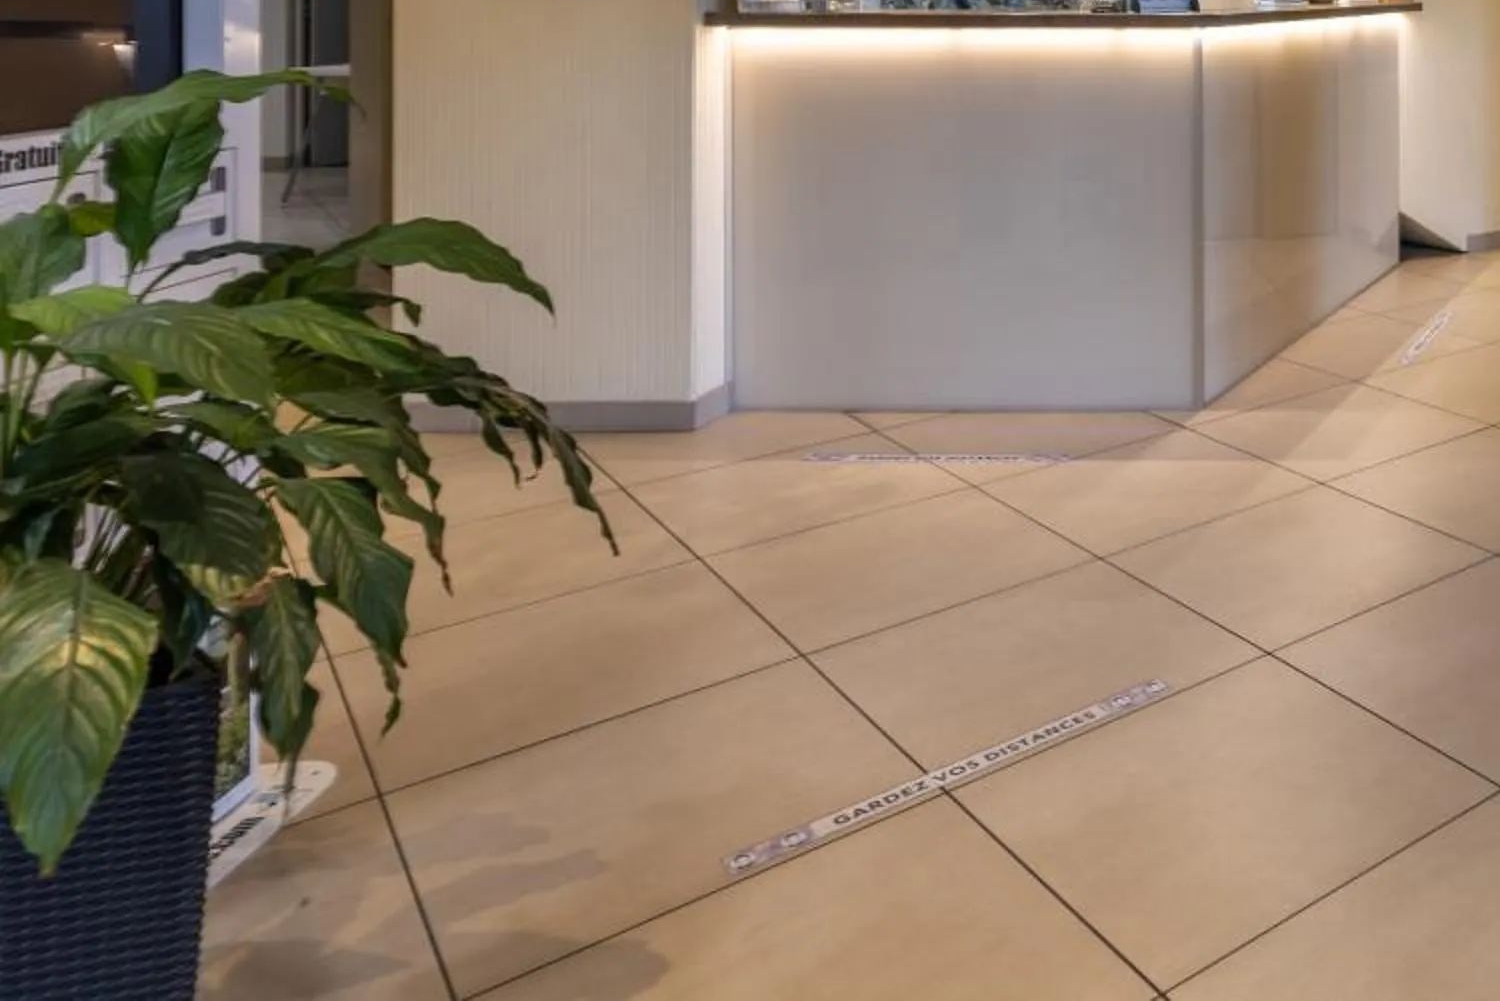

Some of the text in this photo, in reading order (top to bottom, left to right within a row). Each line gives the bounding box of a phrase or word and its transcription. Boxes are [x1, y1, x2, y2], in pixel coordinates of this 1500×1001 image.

[0, 142, 64, 173] ratui
[833, 710, 1097, 825] GARDEZ VOS DISTANCES
